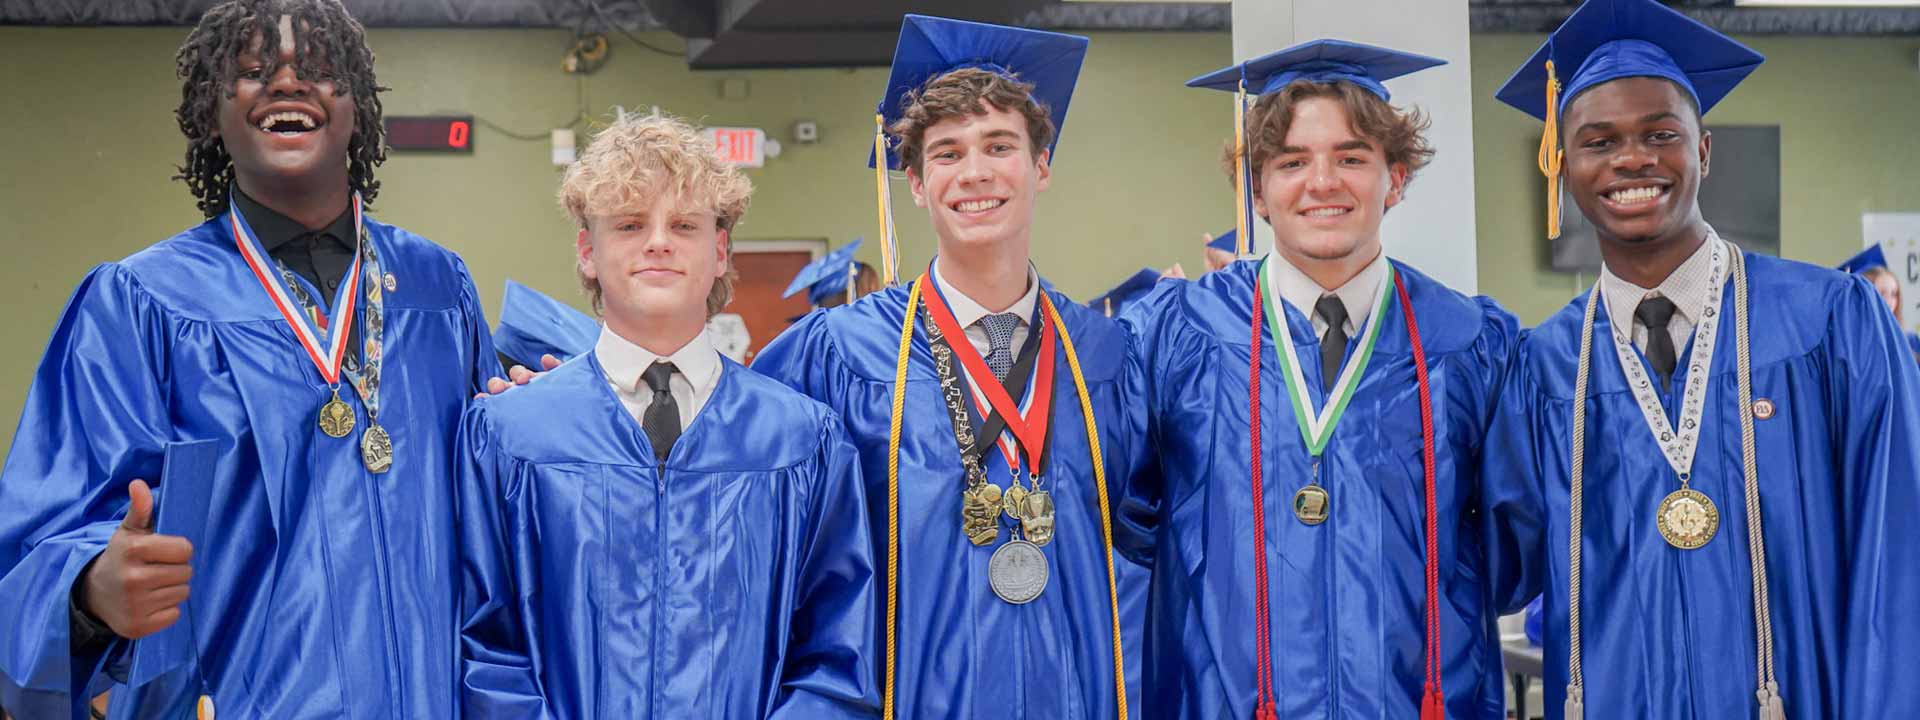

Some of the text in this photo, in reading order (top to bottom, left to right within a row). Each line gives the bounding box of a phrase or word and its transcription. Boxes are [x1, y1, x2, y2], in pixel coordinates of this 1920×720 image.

[449, 121, 468, 147] 0
[715, 129, 755, 162] EXIT
[1907, 252, 1920, 284] C
